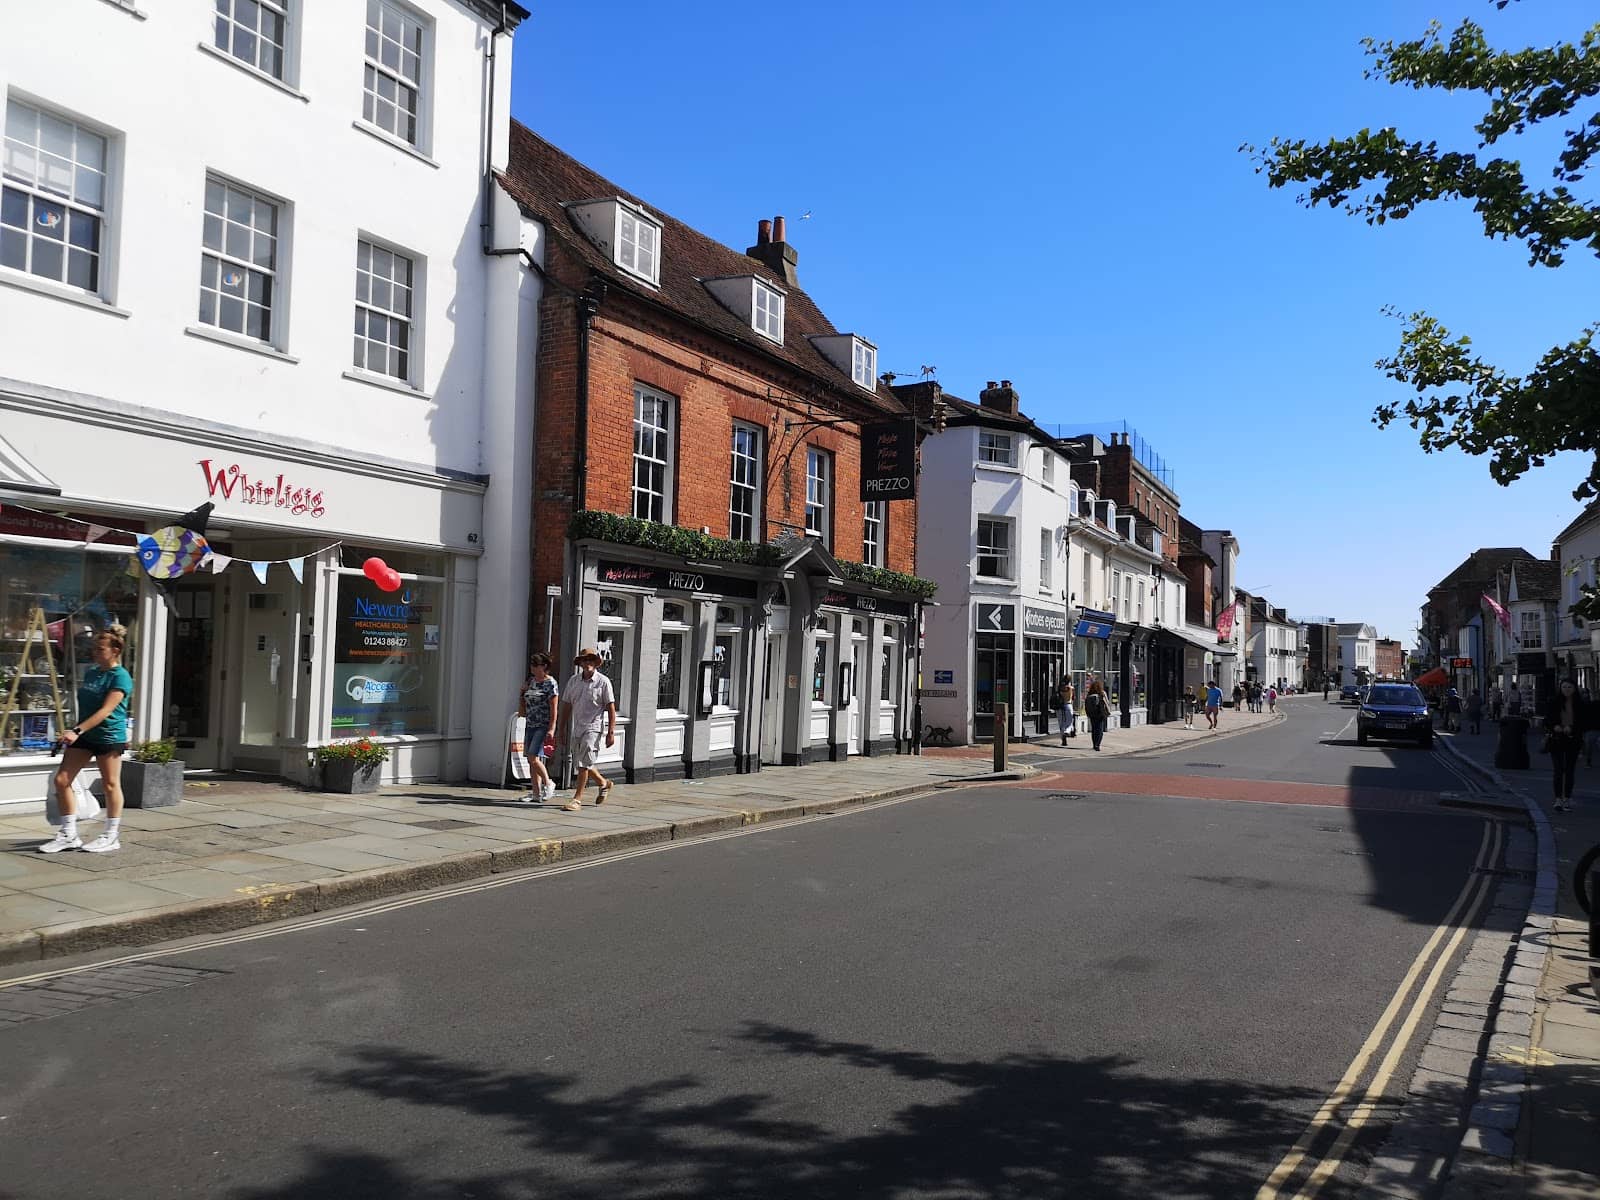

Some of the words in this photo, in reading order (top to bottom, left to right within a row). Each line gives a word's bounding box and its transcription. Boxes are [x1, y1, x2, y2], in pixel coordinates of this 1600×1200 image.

[196, 459, 324, 518] Whirligig
[866, 477, 910, 492] PREZZO
[669, 571, 704, 591] PREZZO
[355, 597, 410, 617] Newcro
[355, 620, 391, 630] HEALTHCARE
[1045, 615, 1065, 631] eyecare
[364, 636, 386, 646] 01243
[364, 681, 395, 691] Access
